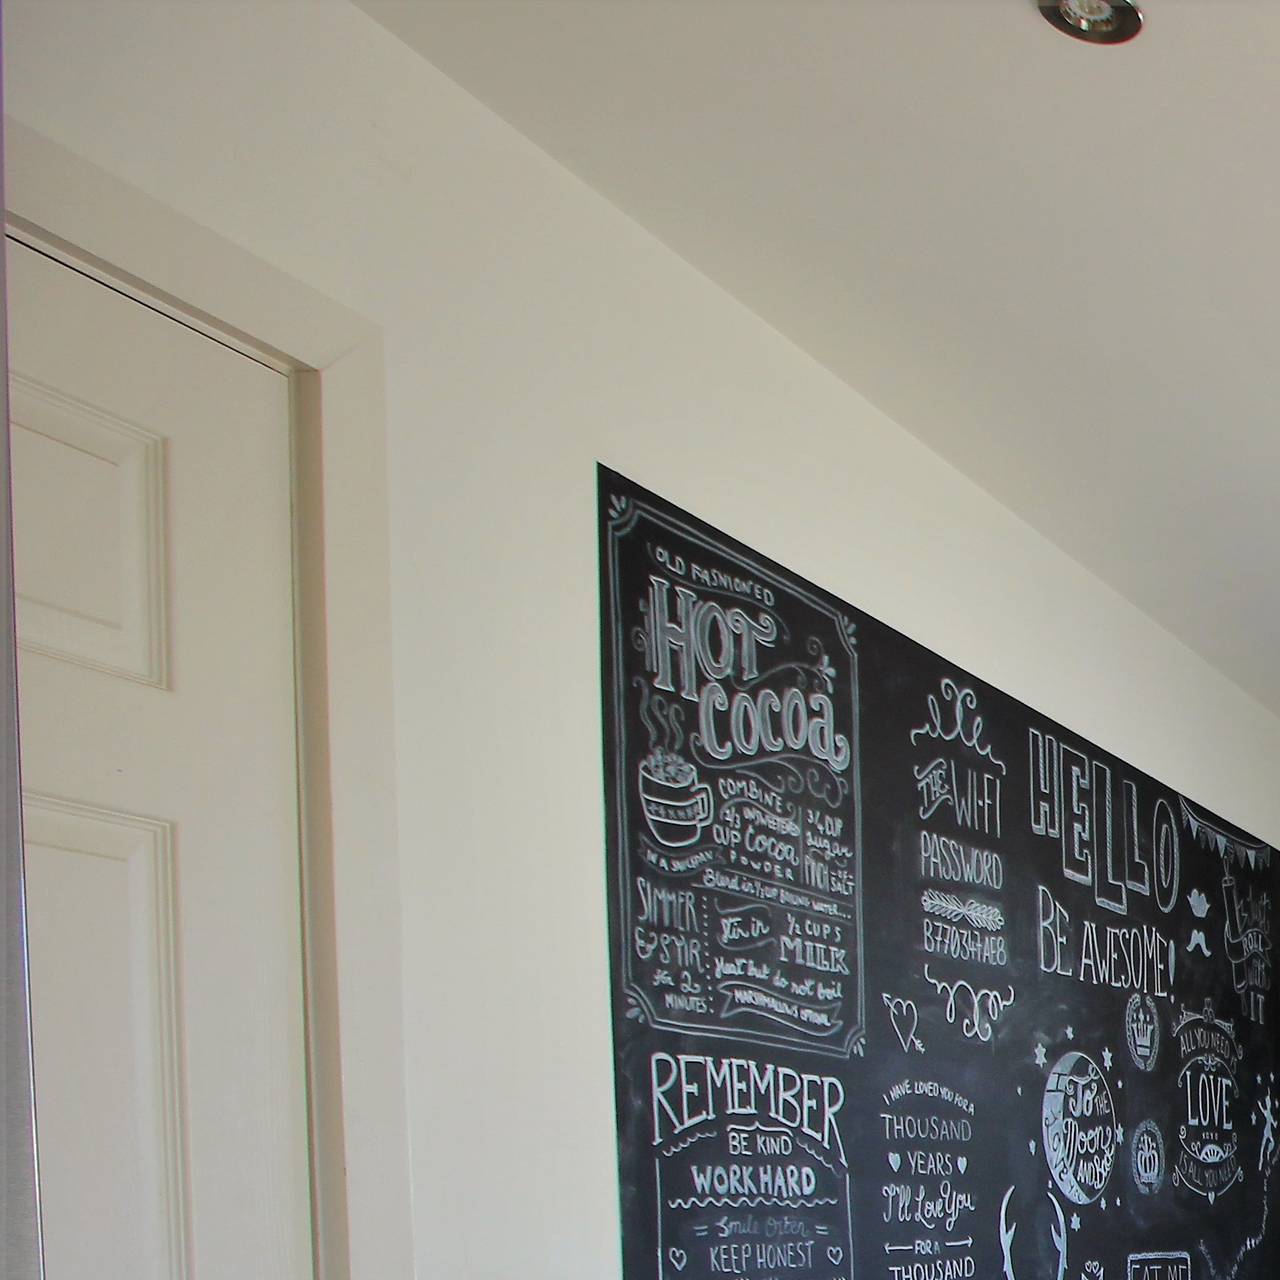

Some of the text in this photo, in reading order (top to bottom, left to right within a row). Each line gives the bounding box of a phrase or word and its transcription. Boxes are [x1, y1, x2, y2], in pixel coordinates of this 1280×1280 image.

[656, 547, 775, 607] OLD FASHIONED
[648, 574, 777, 703] HOT
[718, 778, 783, 813] COMBINE
[918, 760, 1001, 838] THE WI-FI
[713, 824, 741, 848] CUP
[824, 815, 843, 837] CUP
[1029, 727, 1180, 915] HELLO
[730, 850, 794, 881] POWDER
[920, 830, 1004, 889] PASSWORD
[830, 880, 854, 895] SALT
[637, 876, 699, 932] SIMMER
[804, 920, 841, 942] CUPS
[1038, 885, 1072, 976] BE
[1242, 931, 1264, 957] ROLL
[660, 933, 704, 973] STIR
[780, 935, 850, 975] MILK
[665, 994, 707, 1013] MINUTES
[790, 979, 815, 997] not
[817, 982, 843, 1000] boil
[1250, 991, 1265, 1025] IT
[1180, 1029, 1196, 1059] ALL
[1194, 1028, 1210, 1049] YOU
[1211, 1031, 1230, 1059] NEED
[651, 1052, 848, 1169] REMEMBER
[889, 1078, 912, 1101] HAVE
[914, 1081, 939, 1097] LOVED
[953, 1090, 968, 1111] FOR
[967, 1101, 976, 1117] A
[1095, 1091, 1110, 1117] THE
[1186, 1071, 1233, 1129] LOVE
[880, 1113, 972, 1142] THOUSAND
[728, 1132, 793, 1156] BE KIND
[907, 1151, 953, 1176] YEARS
[1077, 1159, 1095, 1186] AND
[1188, 1160, 1203, 1186] ALL
[691, 1164, 816, 1198] WORK HARD
[709, 1241, 815, 1273] KEEP HONEST
[914, 1239, 932, 1255] FOR
